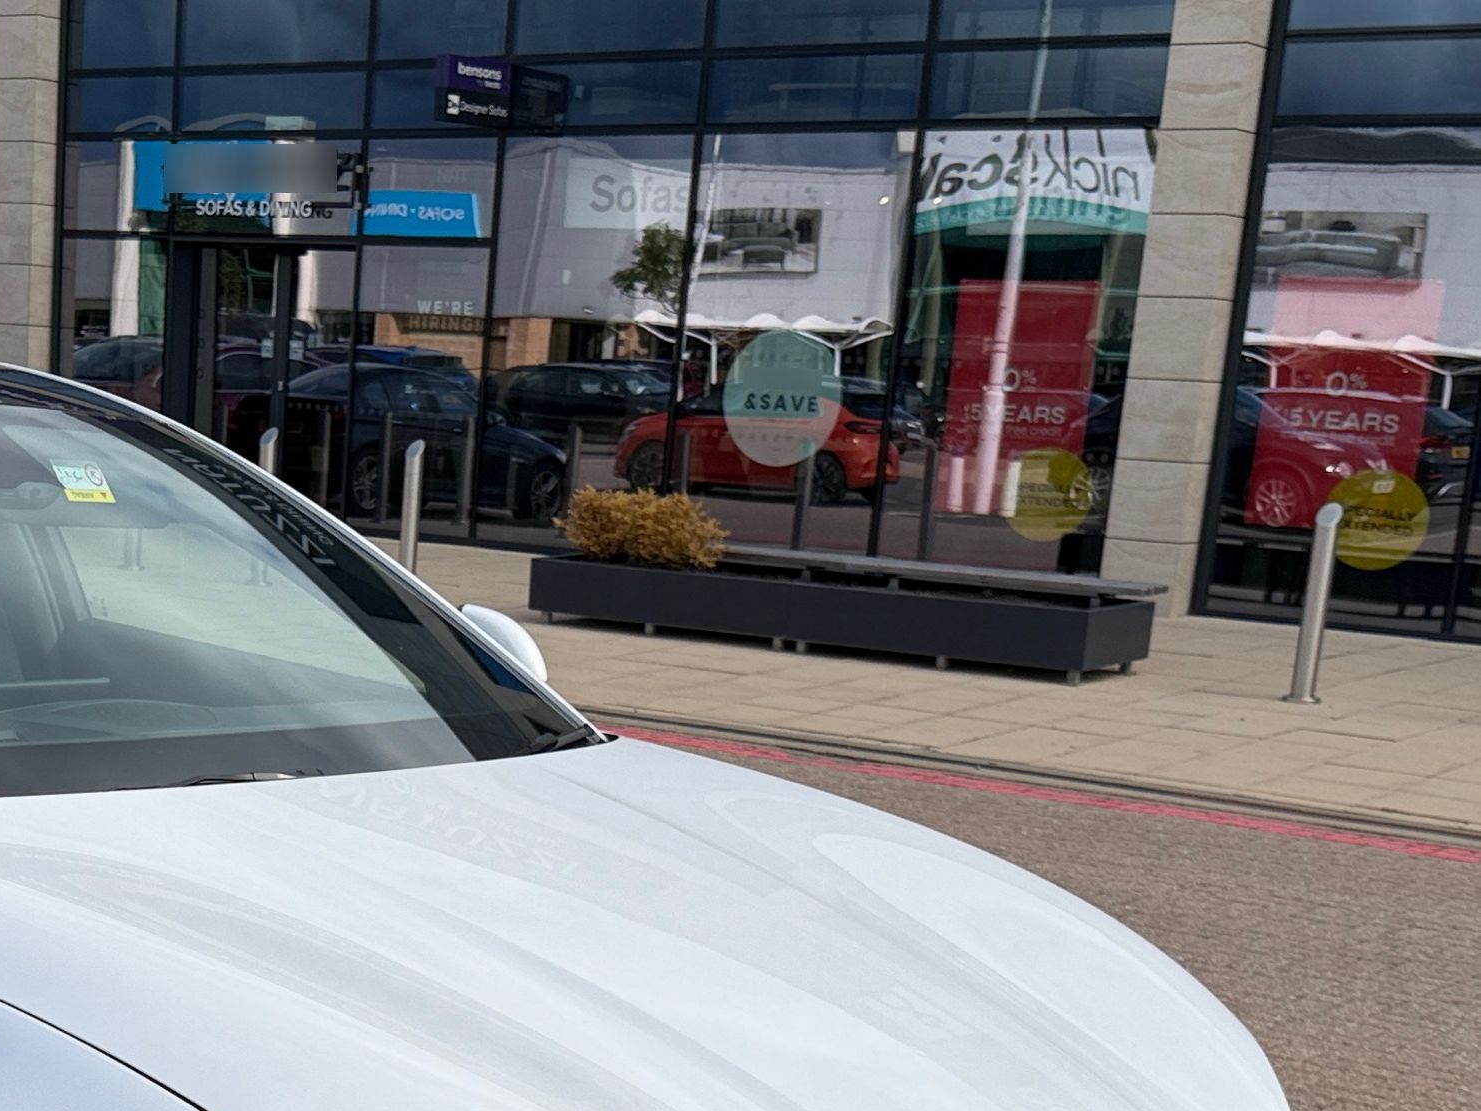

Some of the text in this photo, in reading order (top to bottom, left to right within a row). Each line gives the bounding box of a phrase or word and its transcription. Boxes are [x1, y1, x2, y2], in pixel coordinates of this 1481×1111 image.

[457, 61, 502, 81] bensons
[590, 174, 691, 213] Sofas
[195, 199, 243, 218] SOFAS
[245, 199, 256, 217] &
[257, 199, 313, 218] DINING
[417, 300, 474, 315] WE'RE
[1326, 371, 1368, 396] 0%
[1306, 409, 1400, 434] YEARS
